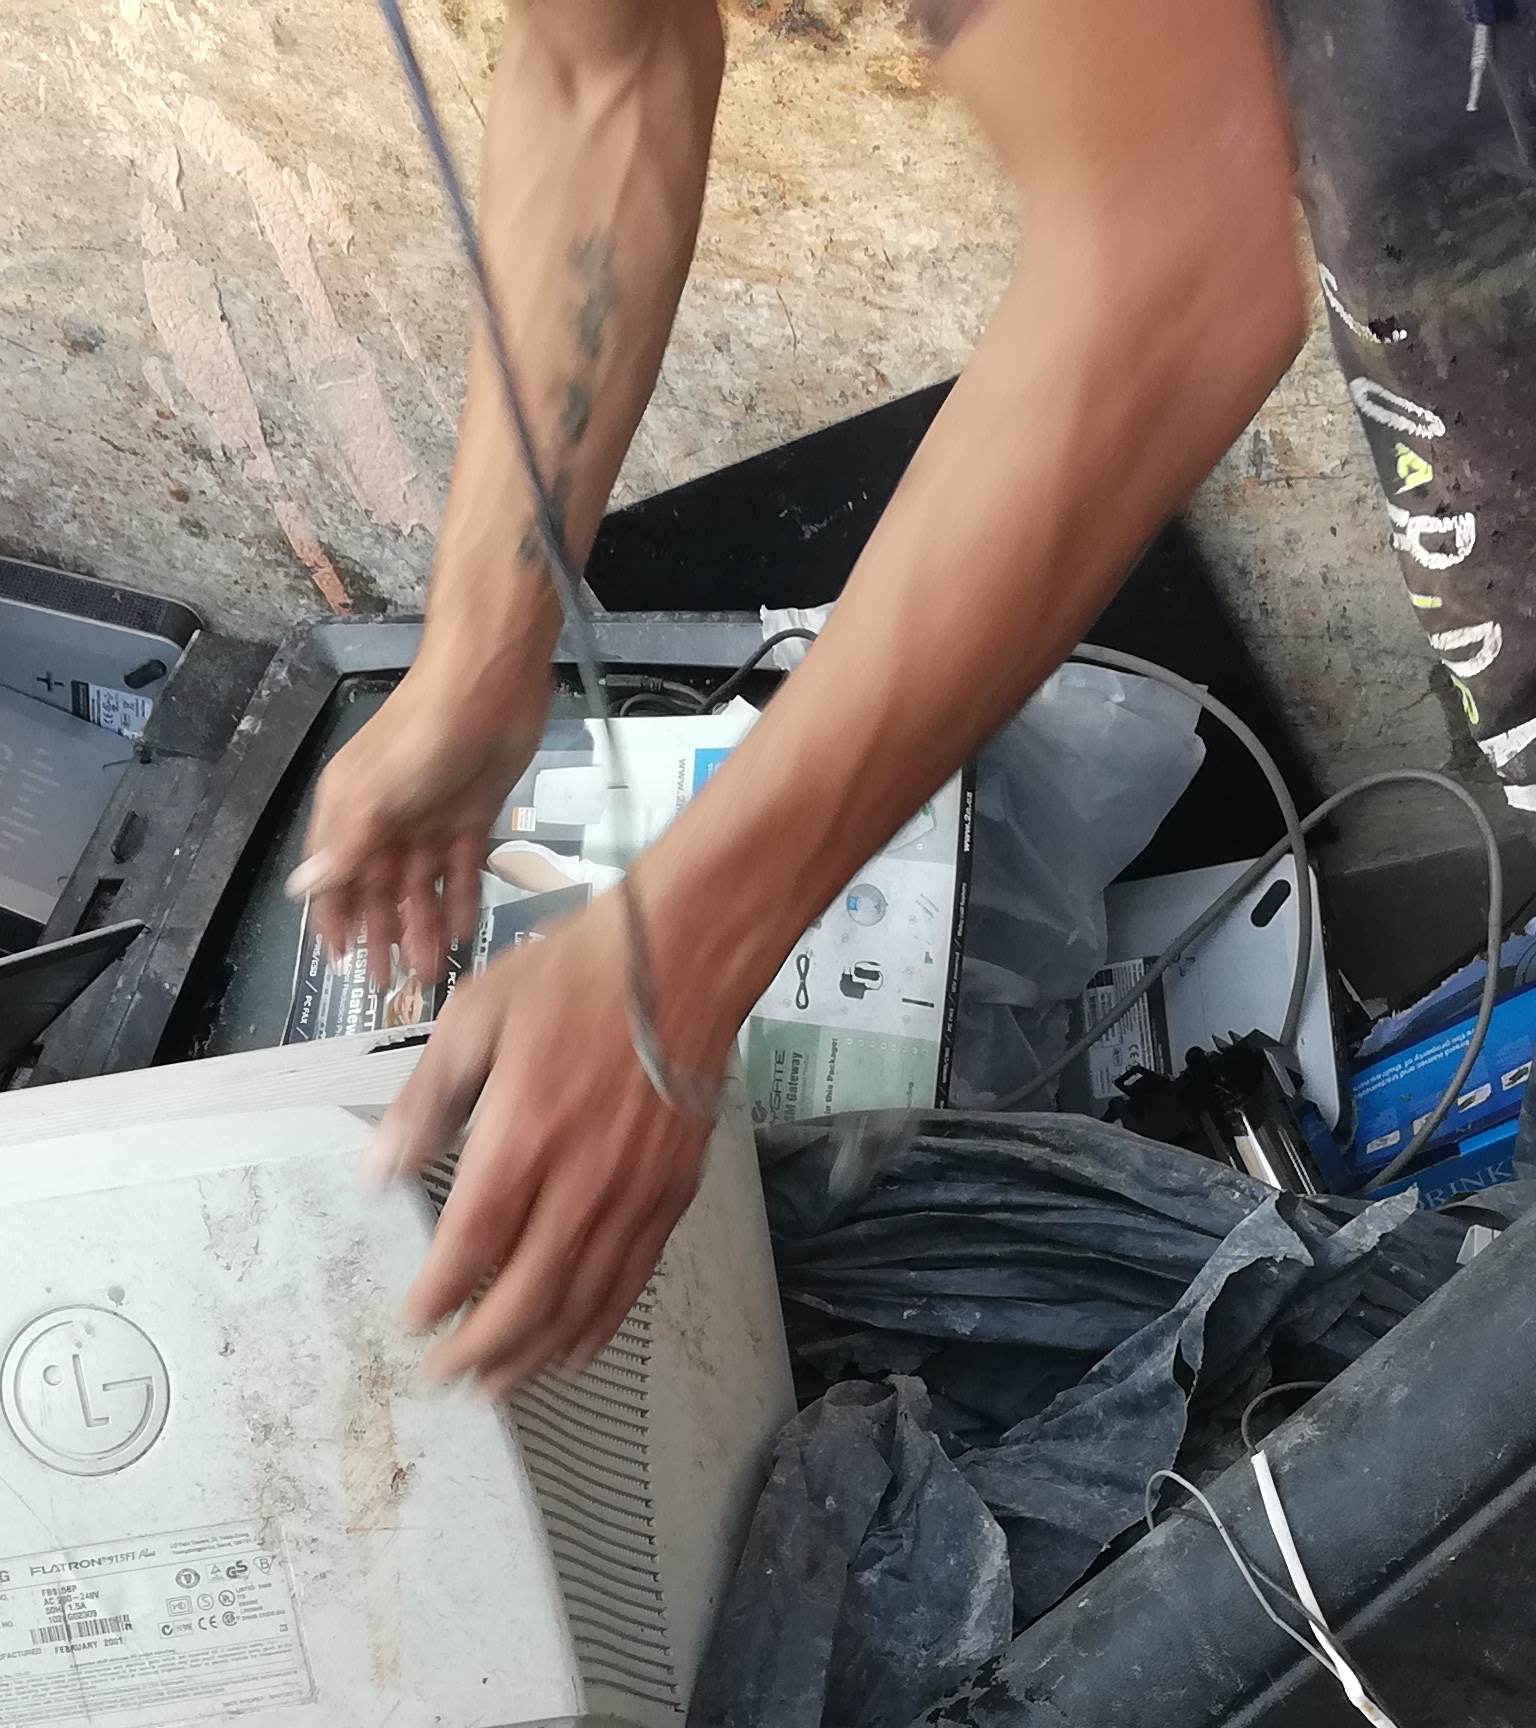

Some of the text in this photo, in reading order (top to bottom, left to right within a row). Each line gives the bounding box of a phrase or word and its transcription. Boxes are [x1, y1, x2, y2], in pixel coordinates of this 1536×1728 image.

[1413, 1039, 1451, 1061] property
[785, 1051, 804, 1102] Gateway
[1419, 1161, 1512, 1210] RINK
[54, 1640, 99, 1655] FEBRUARY
[103, 1636, 124, 1648] 2001
